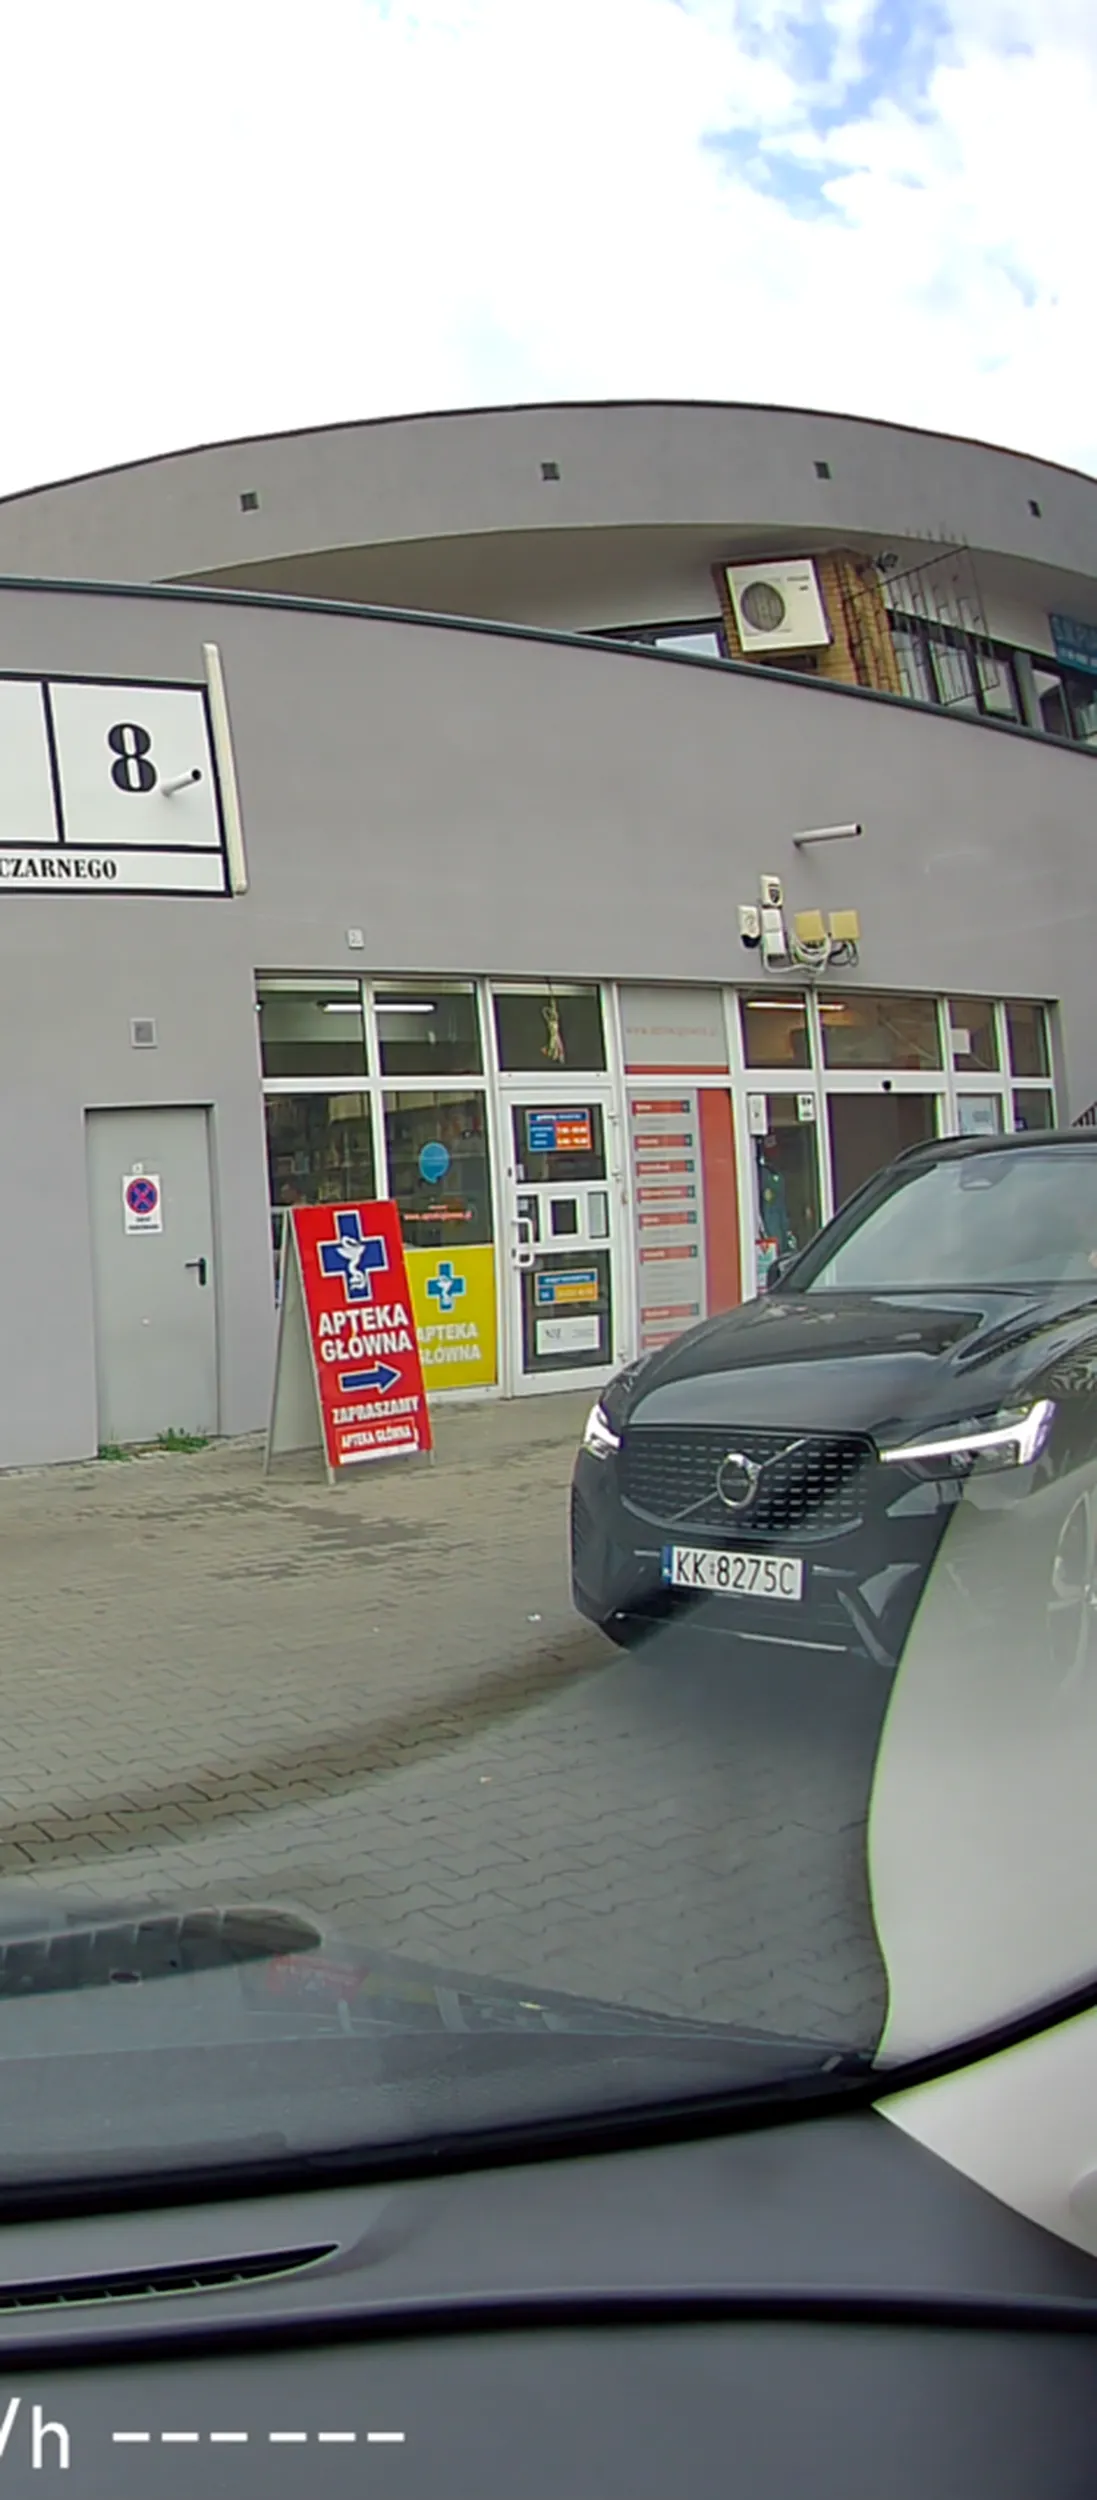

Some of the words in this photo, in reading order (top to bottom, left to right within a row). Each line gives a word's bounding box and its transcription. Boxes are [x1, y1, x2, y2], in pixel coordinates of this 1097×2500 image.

[107, 722, 157, 793] 8
[319, 1303, 409, 1337] APTEKA
[320, 1329, 413, 1363] GŁÓWNA
[332, 1396, 420, 1425] ZAPRASZAMY
[341, 1430, 375, 1449] APTEKA
[676, 1550, 706, 1584] KK
[716, 1555, 795, 1595] 8275C
